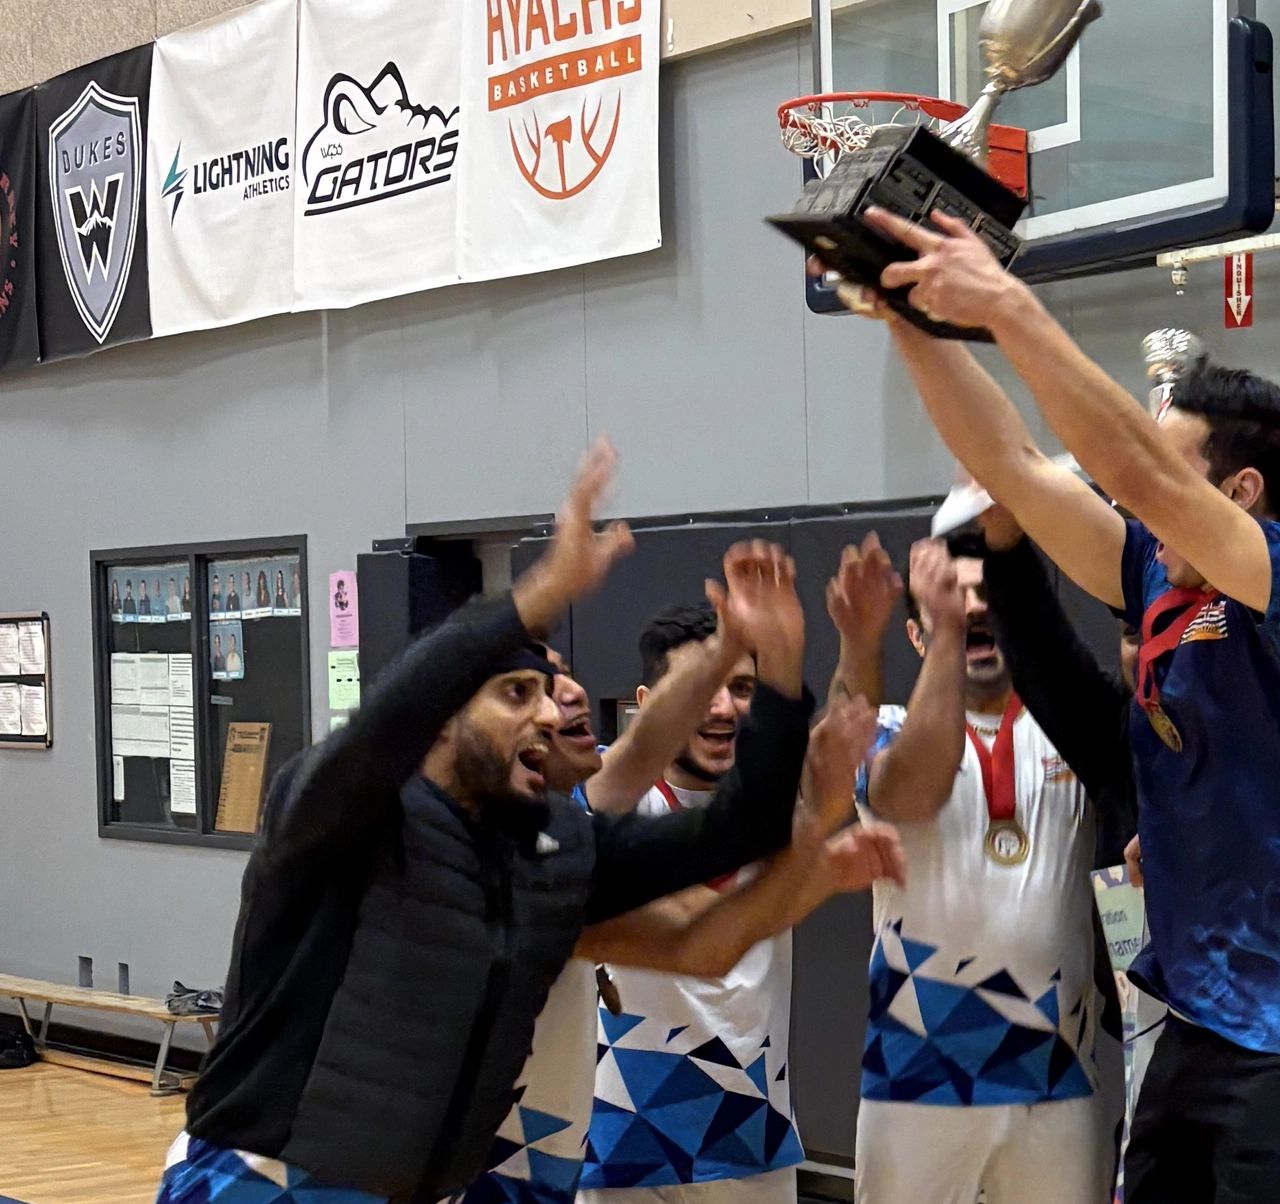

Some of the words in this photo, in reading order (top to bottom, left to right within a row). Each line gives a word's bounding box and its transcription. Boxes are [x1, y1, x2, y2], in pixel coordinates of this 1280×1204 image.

[493, 47, 636, 101] BASKETBALL
[61, 131, 127, 174] DUKES
[193, 137, 290, 194] LIGHTNING
[307, 129, 459, 205] GATORS
[243, 174, 290, 201] ATHLETICS
